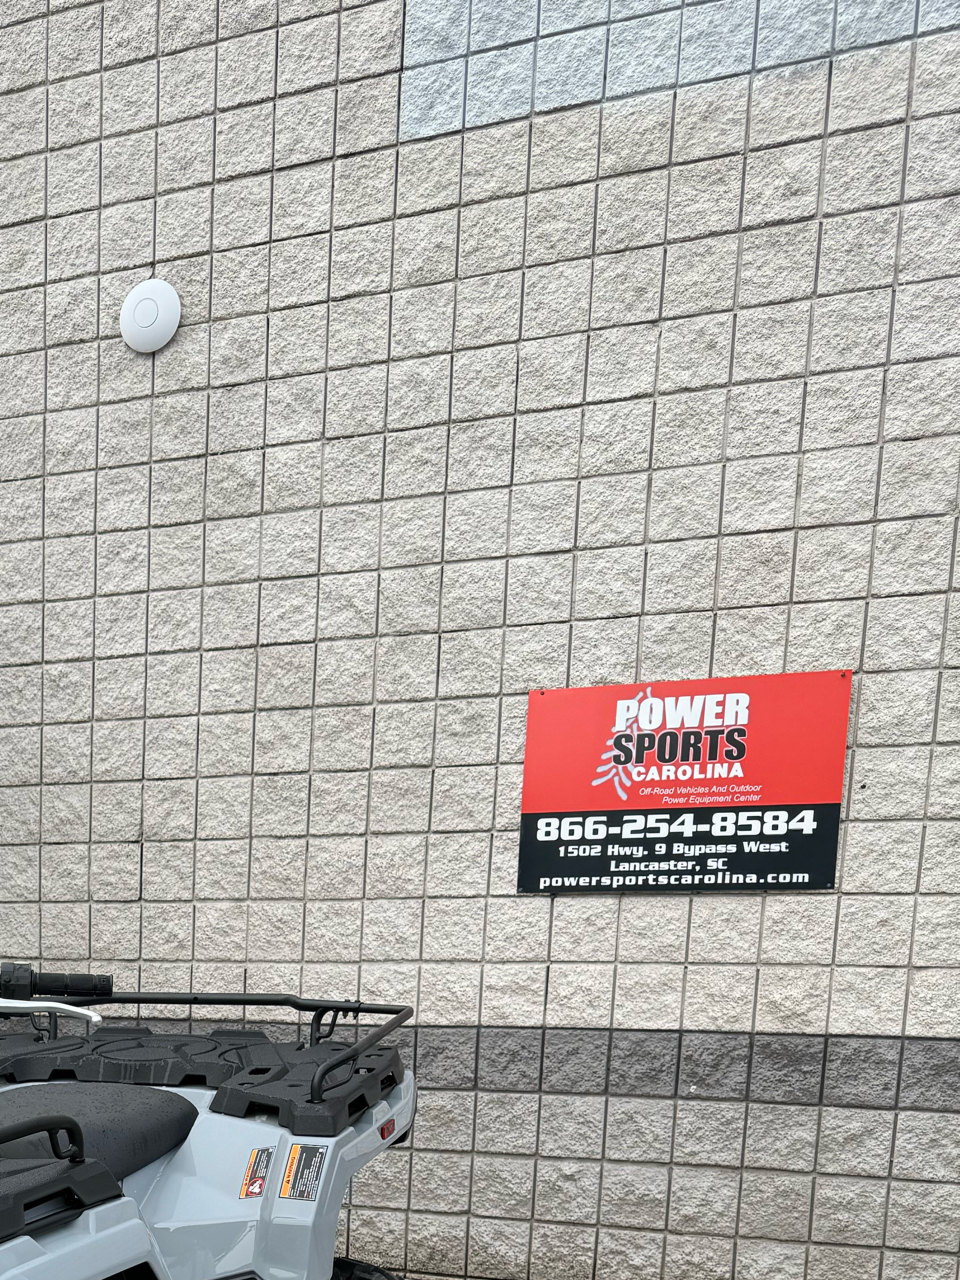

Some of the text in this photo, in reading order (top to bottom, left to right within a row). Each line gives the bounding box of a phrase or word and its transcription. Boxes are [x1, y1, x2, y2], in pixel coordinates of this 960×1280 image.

[614, 692, 751, 732] POWER
[612, 726, 748, 767] SPORTS
[631, 762, 745, 782] CAROLINA
[639, 784, 763, 796] Off-Road Vehicles And Outdoor
[661, 793, 762, 805] Power Equipment Center
[535, 809, 818, 842] 866-254-8584
[558, 841, 790, 858] 1502 Hwy. 9 Bypass West
[609, 858, 728, 872] Lancaster, SC
[538, 871, 810, 890] powersportscarolina.com
